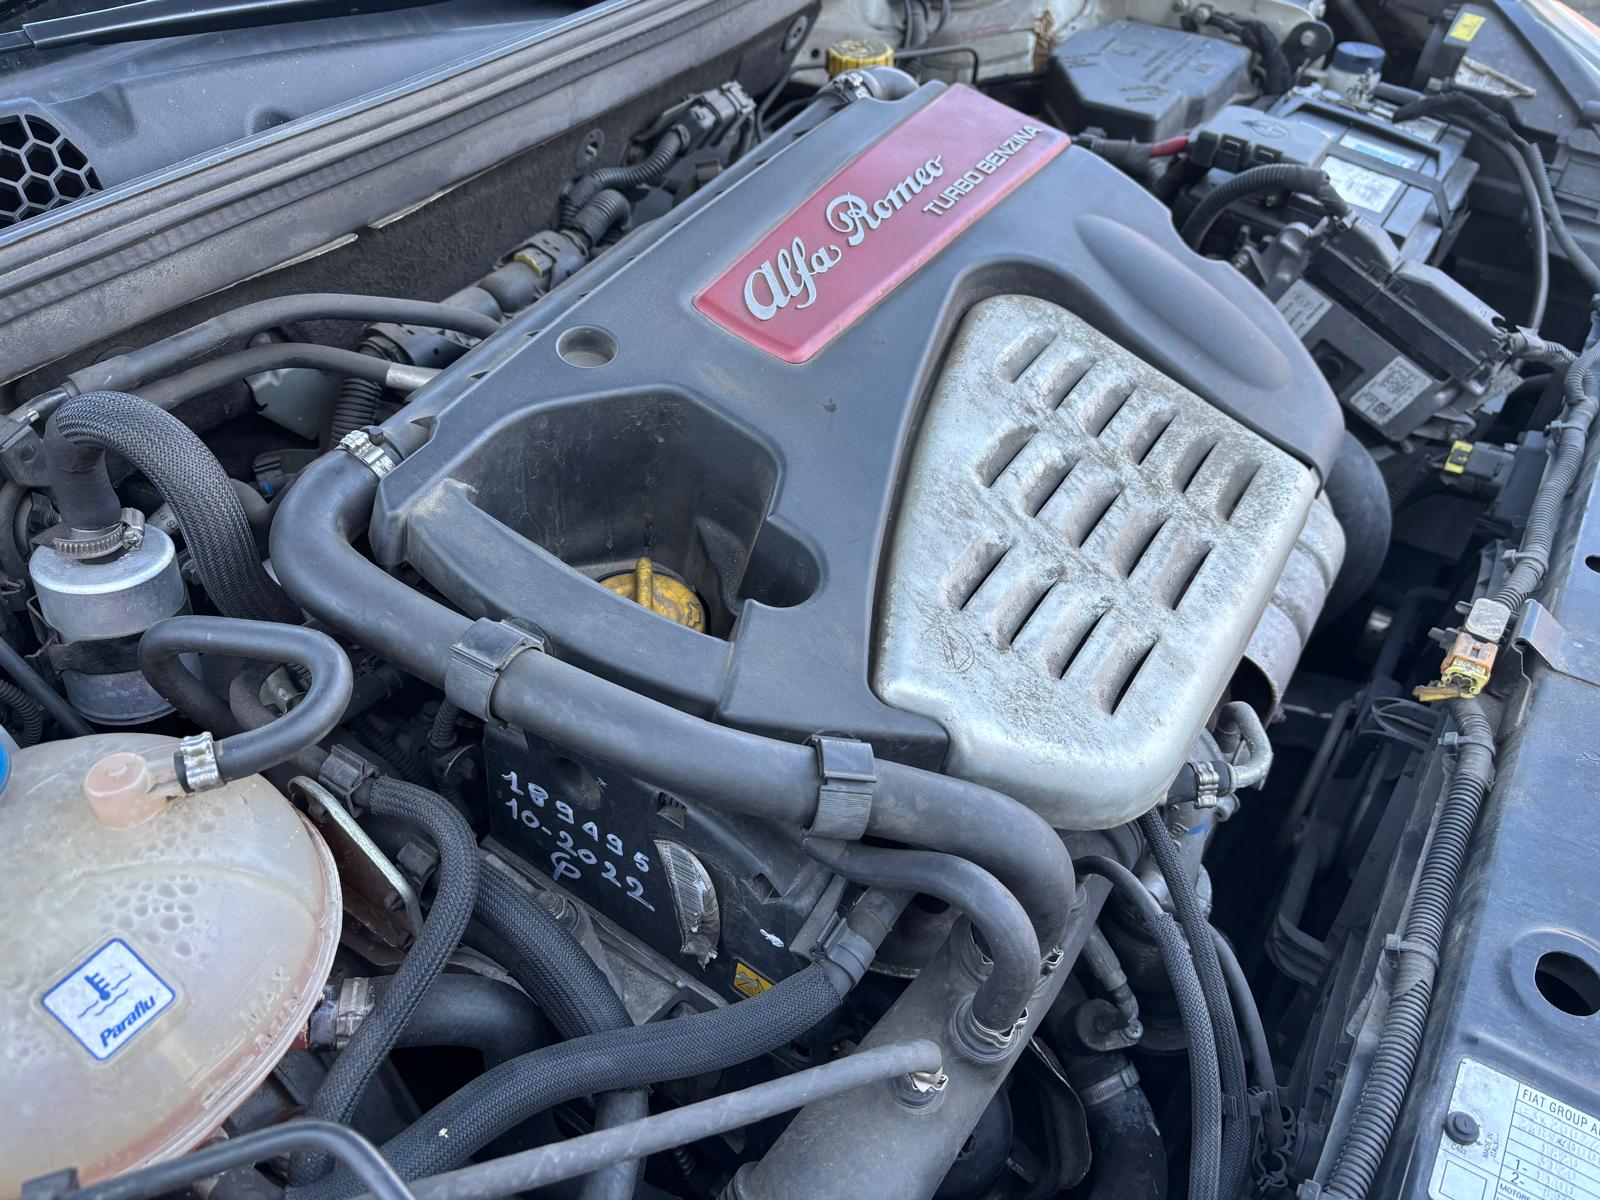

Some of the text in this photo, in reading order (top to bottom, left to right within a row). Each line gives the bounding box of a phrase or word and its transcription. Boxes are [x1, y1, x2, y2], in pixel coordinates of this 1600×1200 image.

[923, 123, 1042, 217] TURBO BENZINA
[743, 155, 944, 321] Alfa Romeo
[100, 996, 155, 1048] Paraflu
[1522, 1089, 1546, 1108] FIAT
[1549, 1102, 1588, 1127] GROUP
